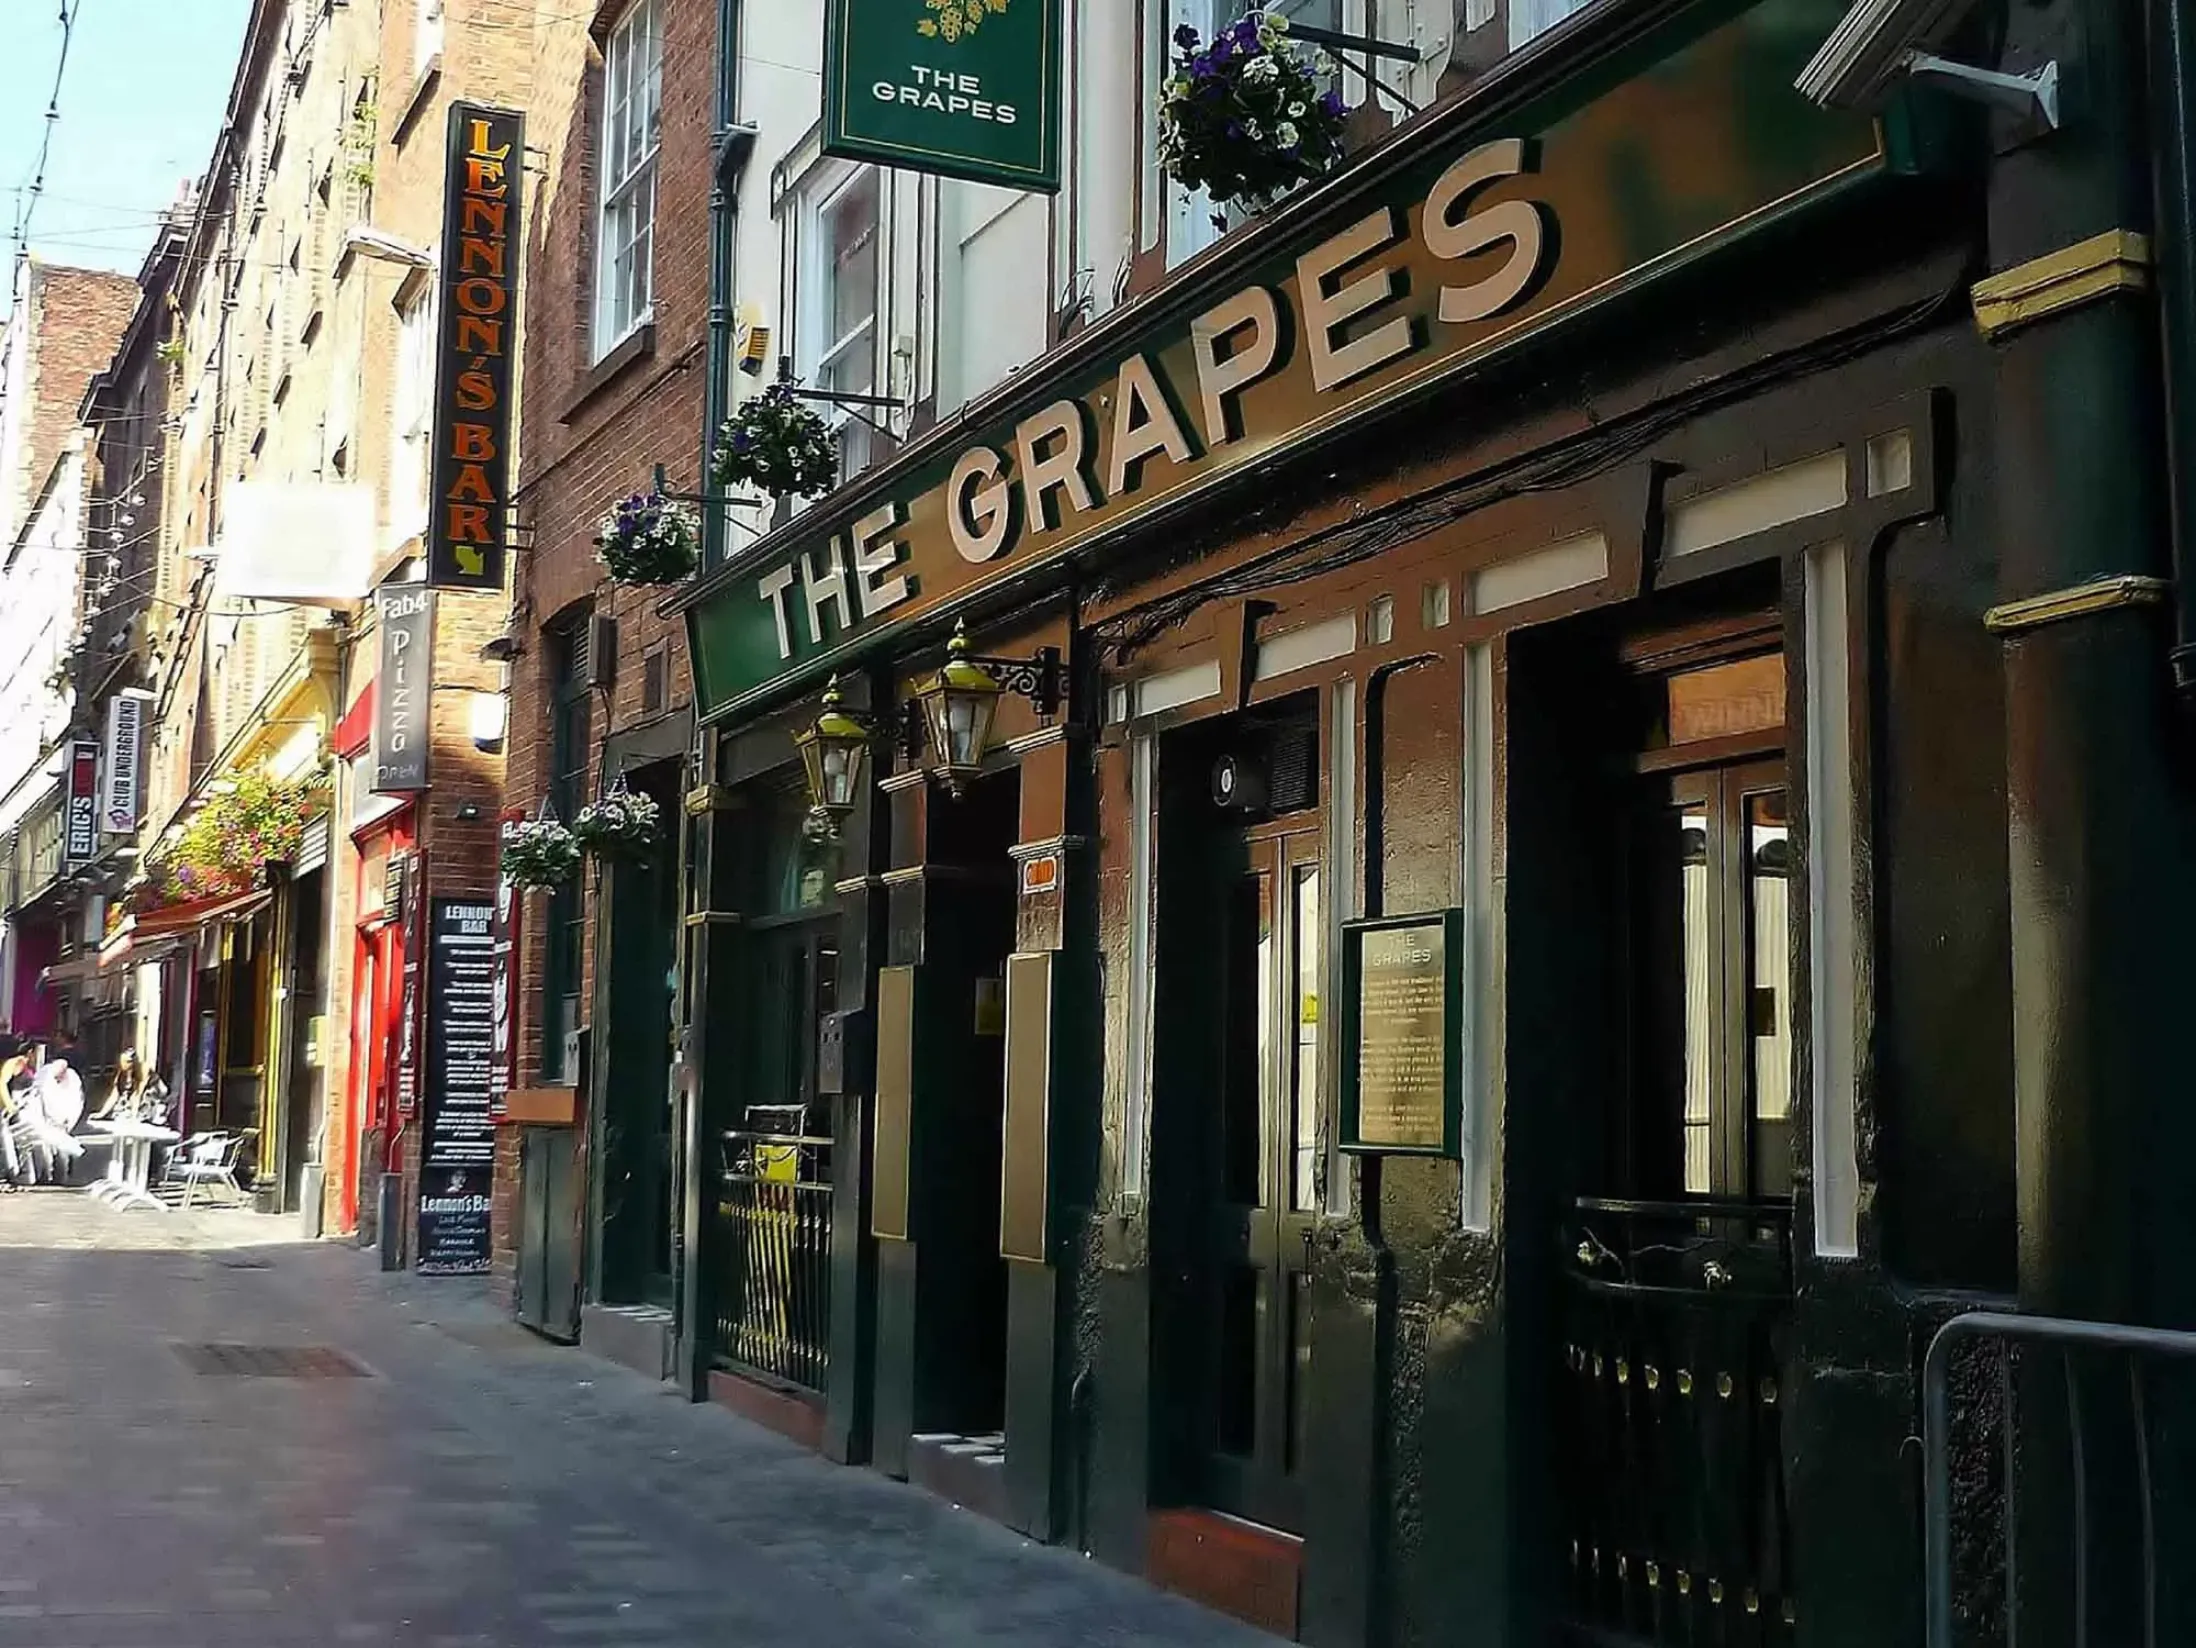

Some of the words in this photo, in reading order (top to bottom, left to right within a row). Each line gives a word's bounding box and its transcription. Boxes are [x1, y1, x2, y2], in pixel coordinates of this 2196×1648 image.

[911, 65, 981, 95] THE
[872, 81, 1017, 124] GRAPES
[456, 119, 511, 411] LENNON'S
[758, 502, 911, 660] THE
[946, 137, 1544, 564] GRAPES
[447, 422, 497, 542] BAR
[381, 591, 428, 620] Fab4
[115, 701, 137, 778] UNDERGROUND
[113, 779, 130, 808] CLUB
[70, 796, 92, 855] ERIC'S
[1373, 949, 1431, 967] GRAPES
[1388, 933, 1415, 949] THE
